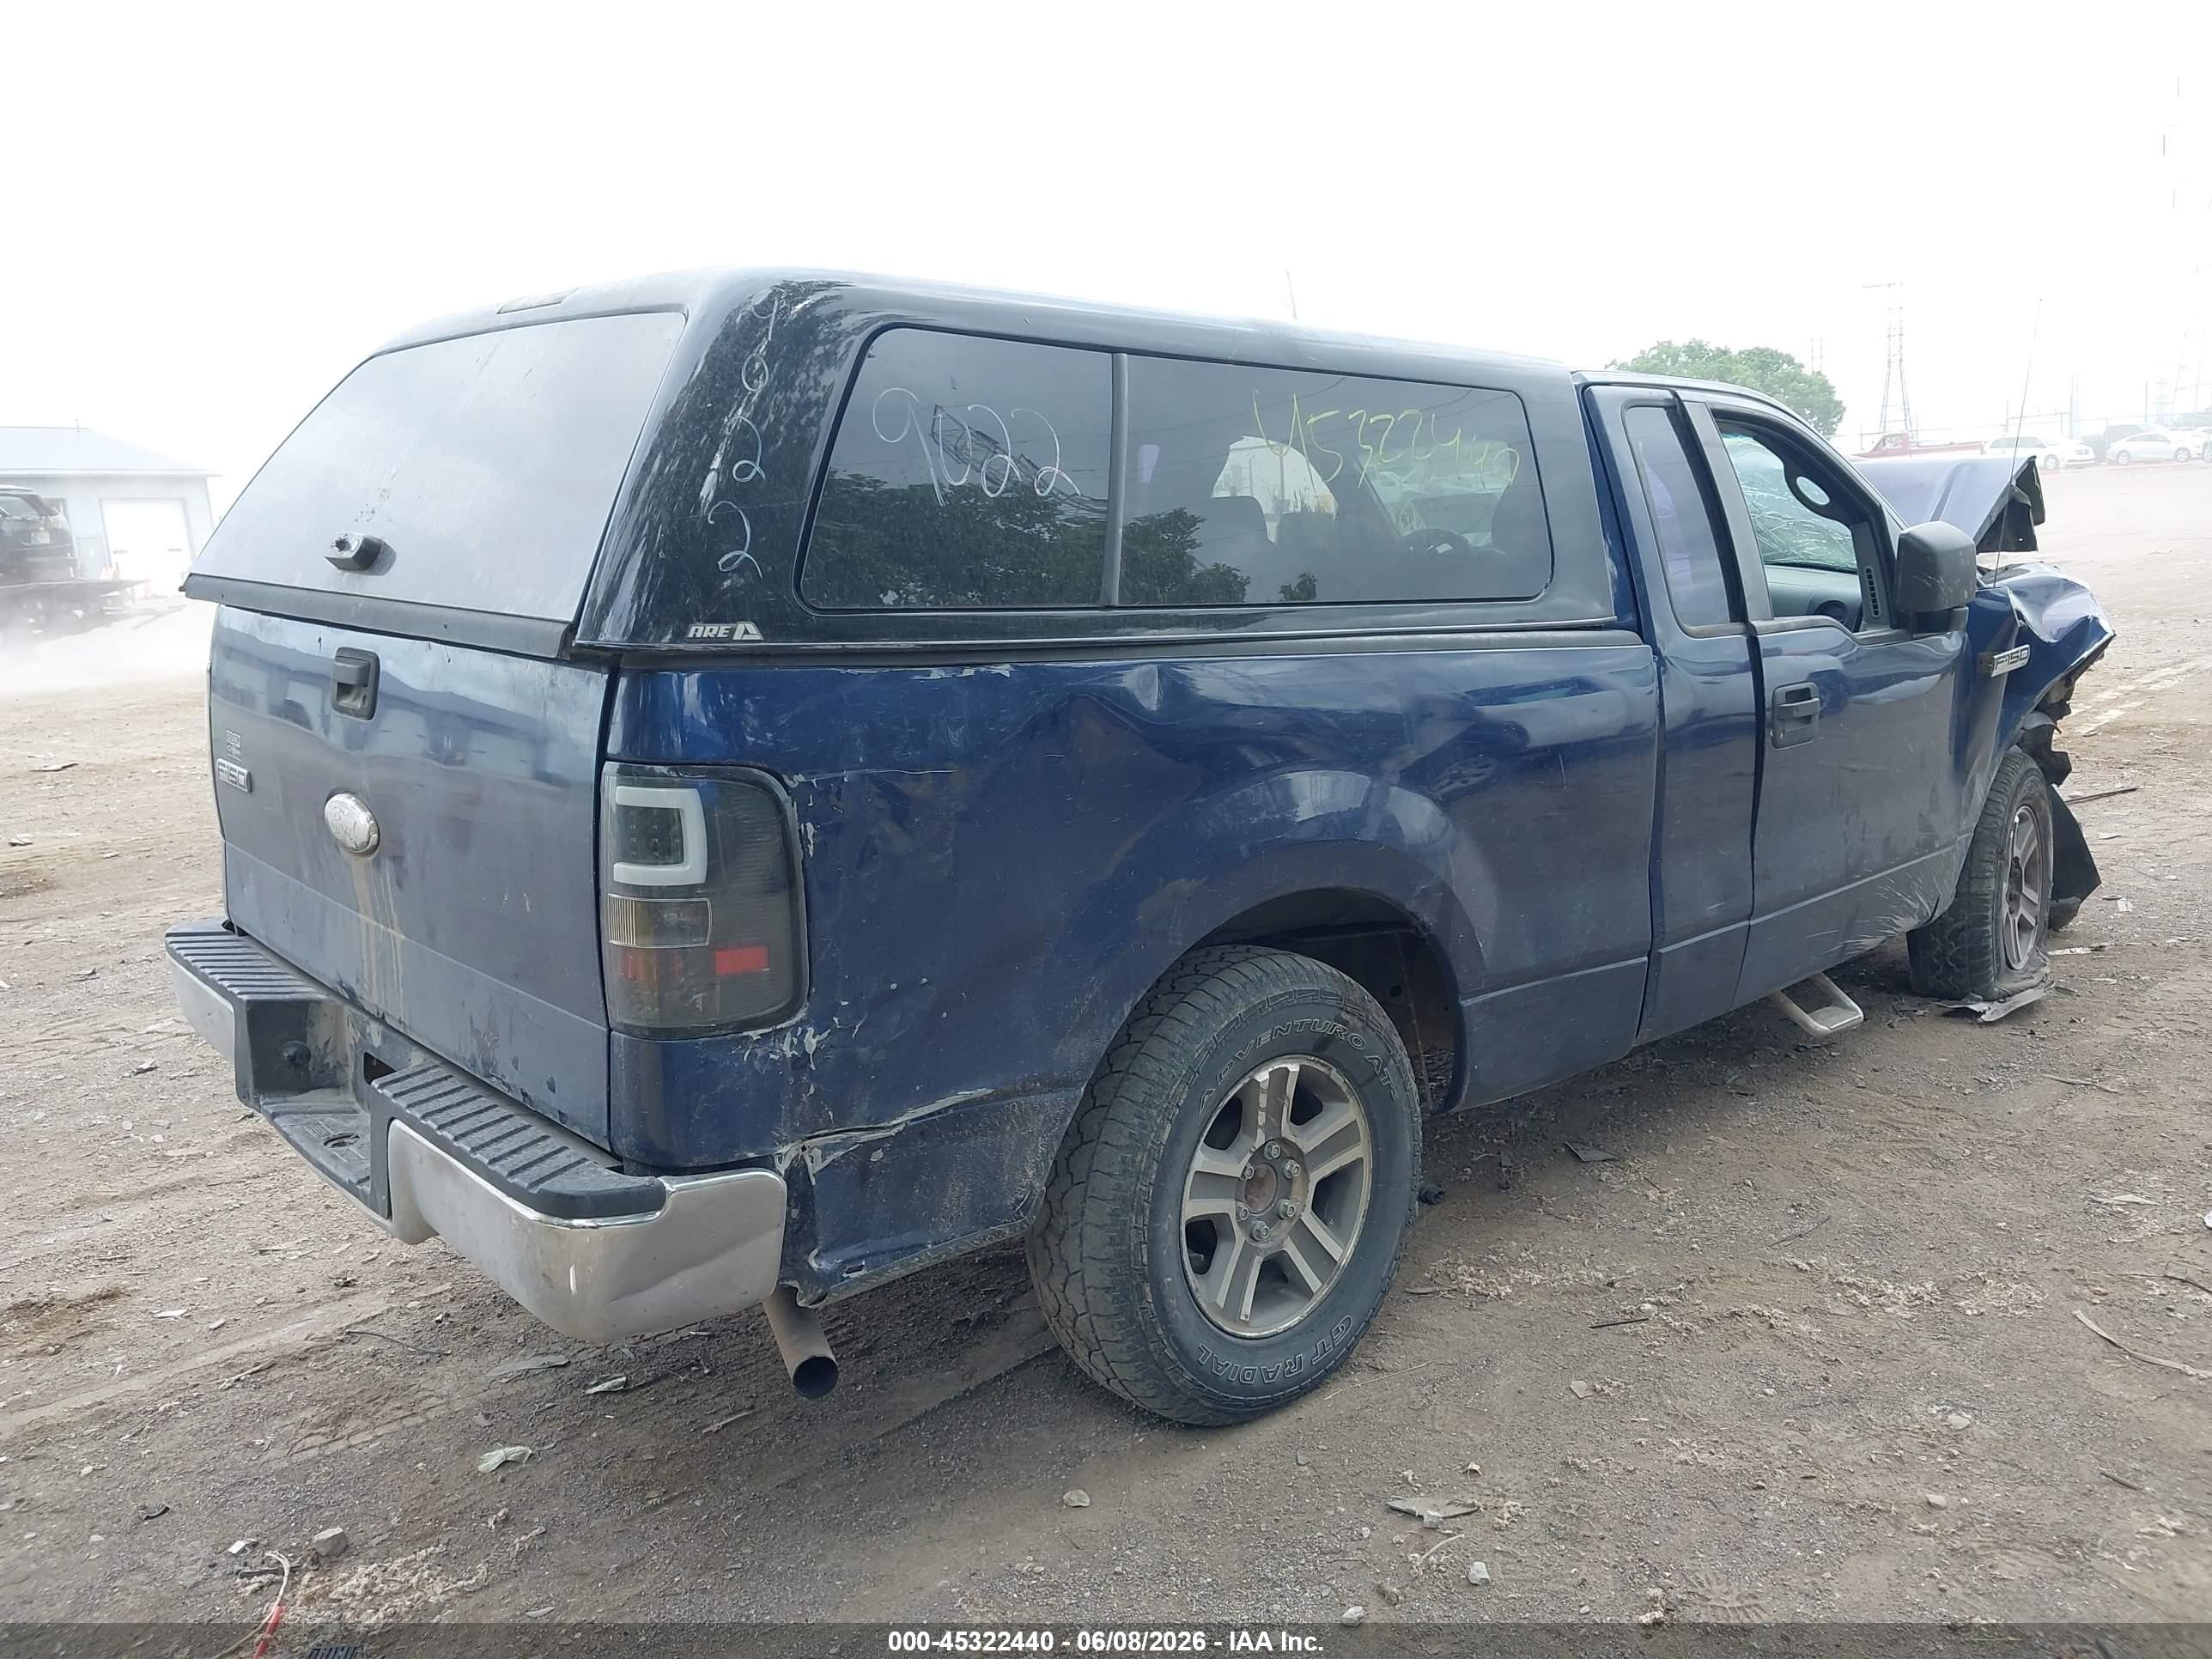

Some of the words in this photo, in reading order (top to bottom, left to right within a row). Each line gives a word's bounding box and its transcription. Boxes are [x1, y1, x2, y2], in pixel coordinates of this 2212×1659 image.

[872, 387, 1082, 507] 9022
[687, 624, 732, 639] ARE
[1199, 1018, 1368, 1115] ADVENTURO
[1198, 1343, 1304, 1384] RADIAL
[1311, 1315, 1353, 1365] GT
